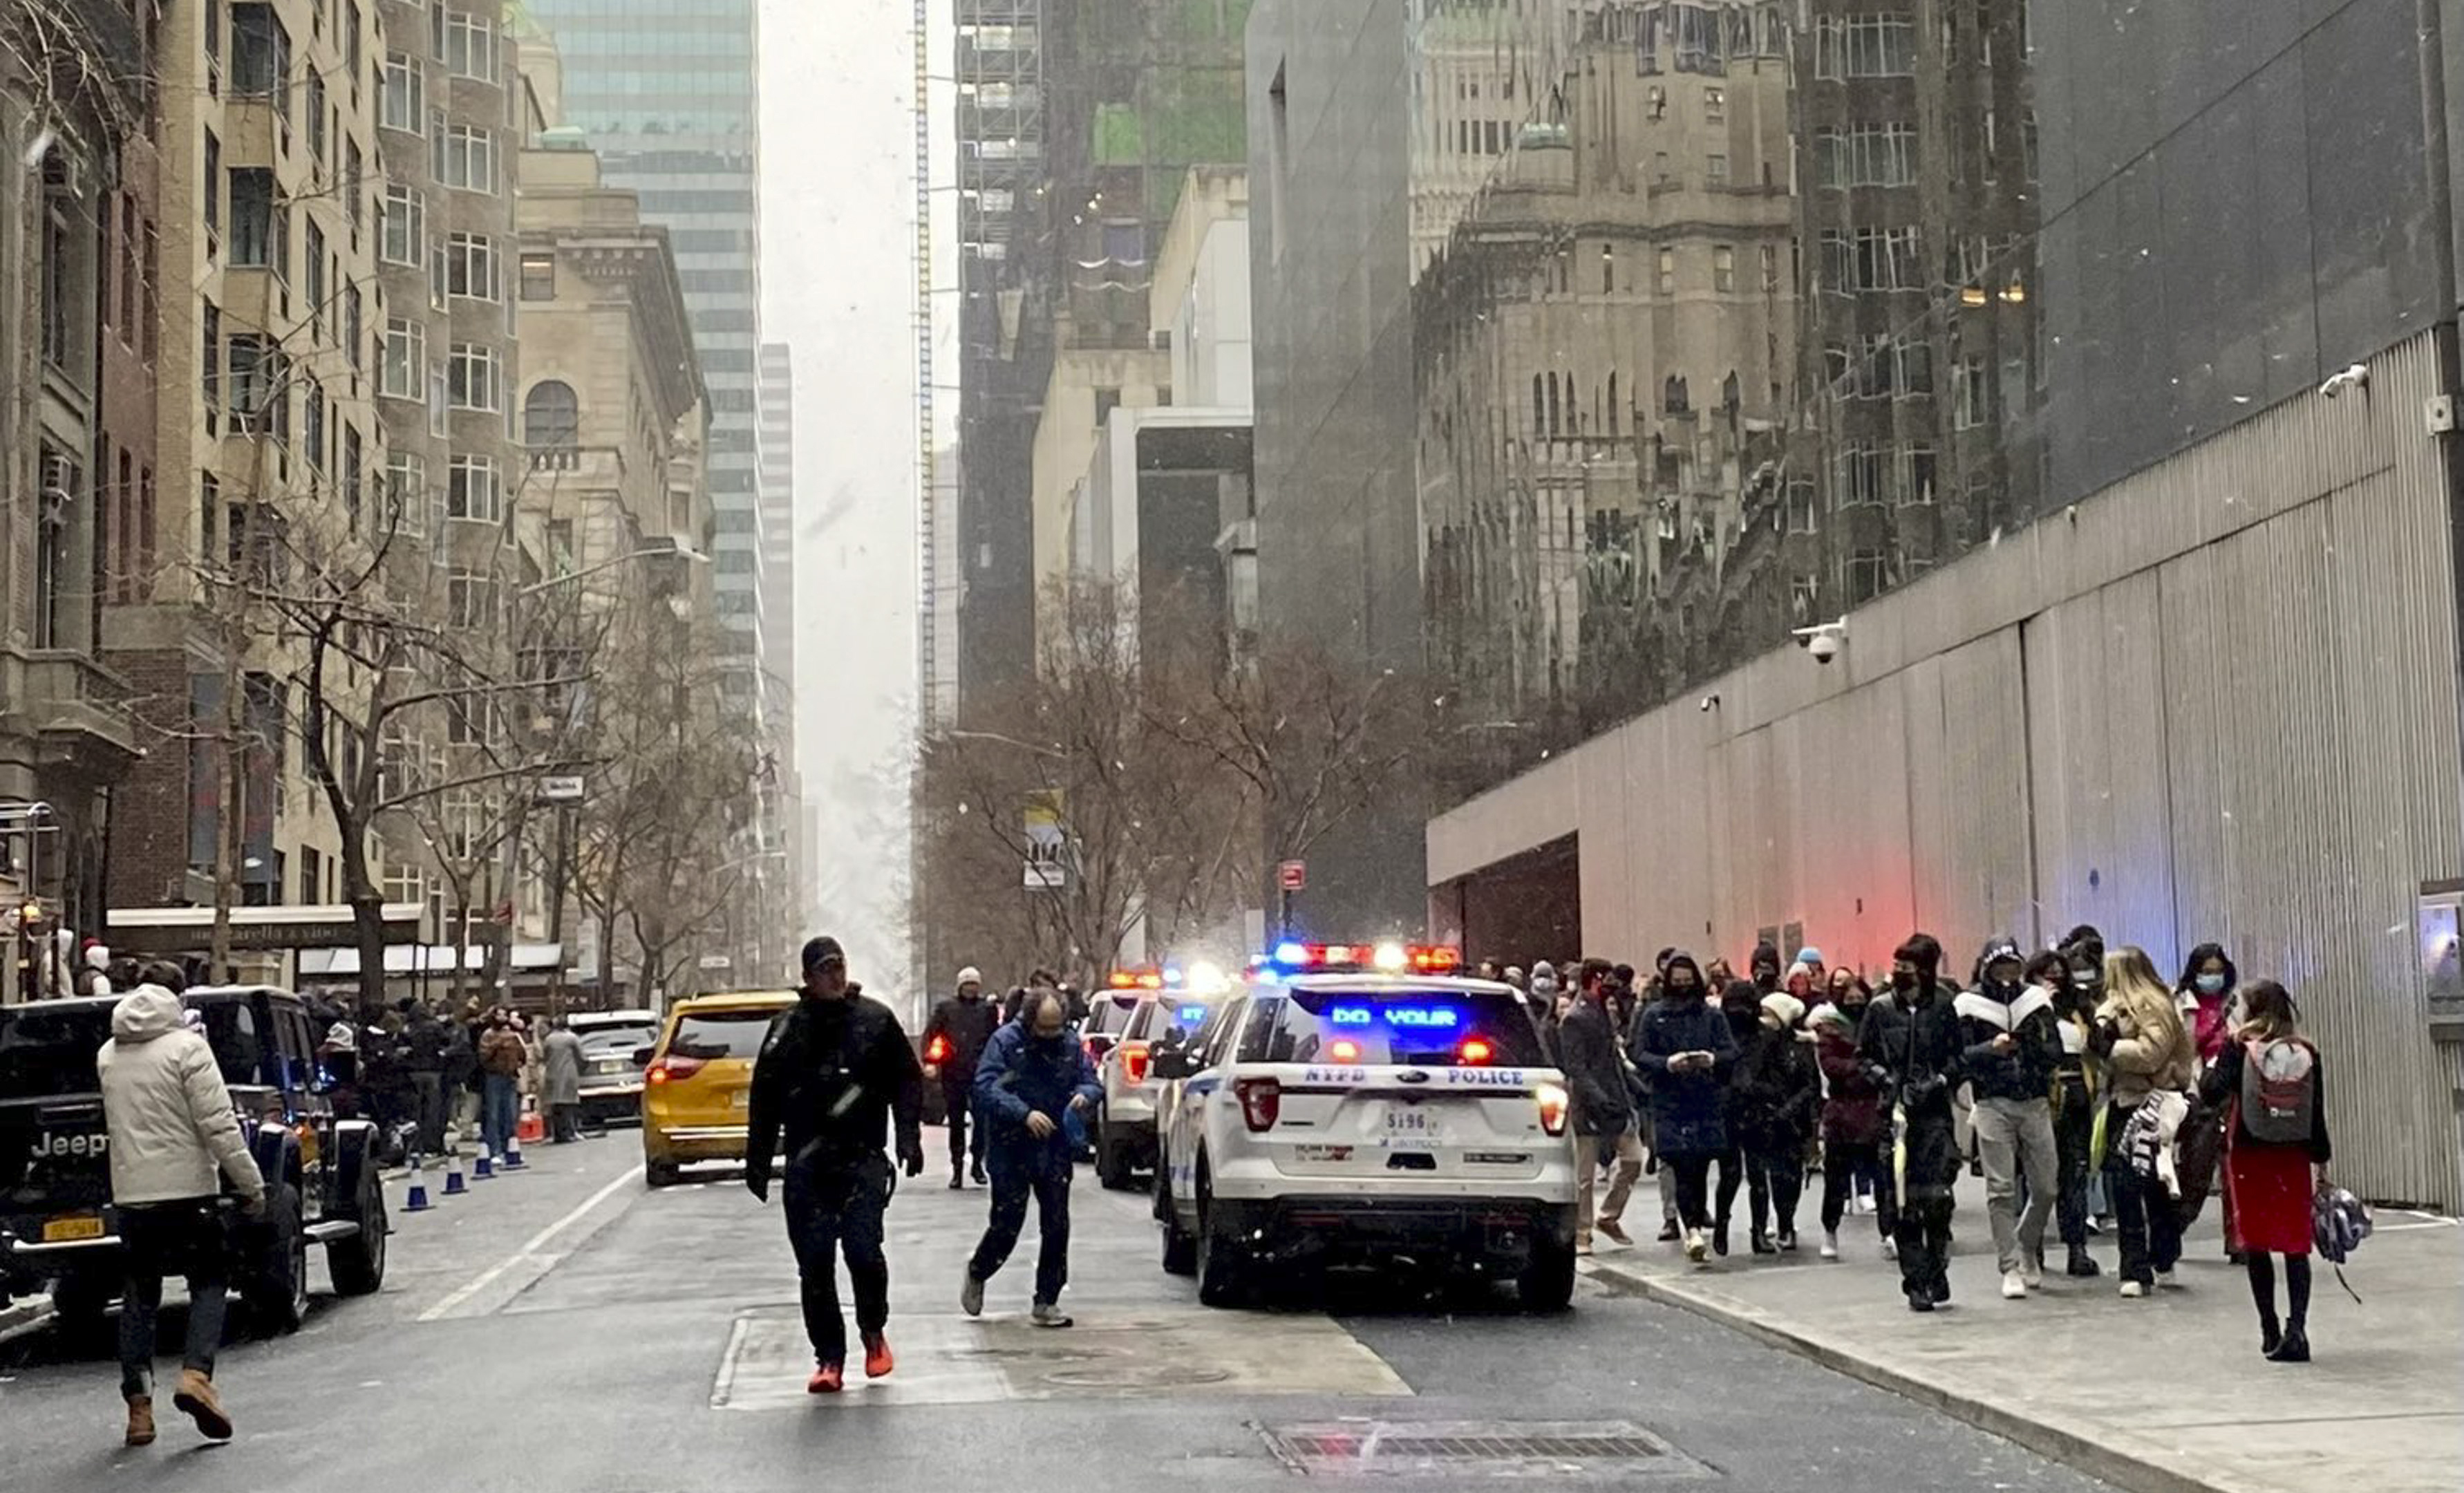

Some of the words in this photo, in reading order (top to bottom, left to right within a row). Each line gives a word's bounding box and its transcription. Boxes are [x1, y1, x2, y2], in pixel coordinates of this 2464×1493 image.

[1332, 1007, 1371, 1023] DO
[1384, 1009, 1457, 1026] YOUR
[1305, 1069, 1365, 1082] NYPD
[1448, 1070, 1524, 1086] POLICE
[30, 1132, 109, 1158] Jeep
